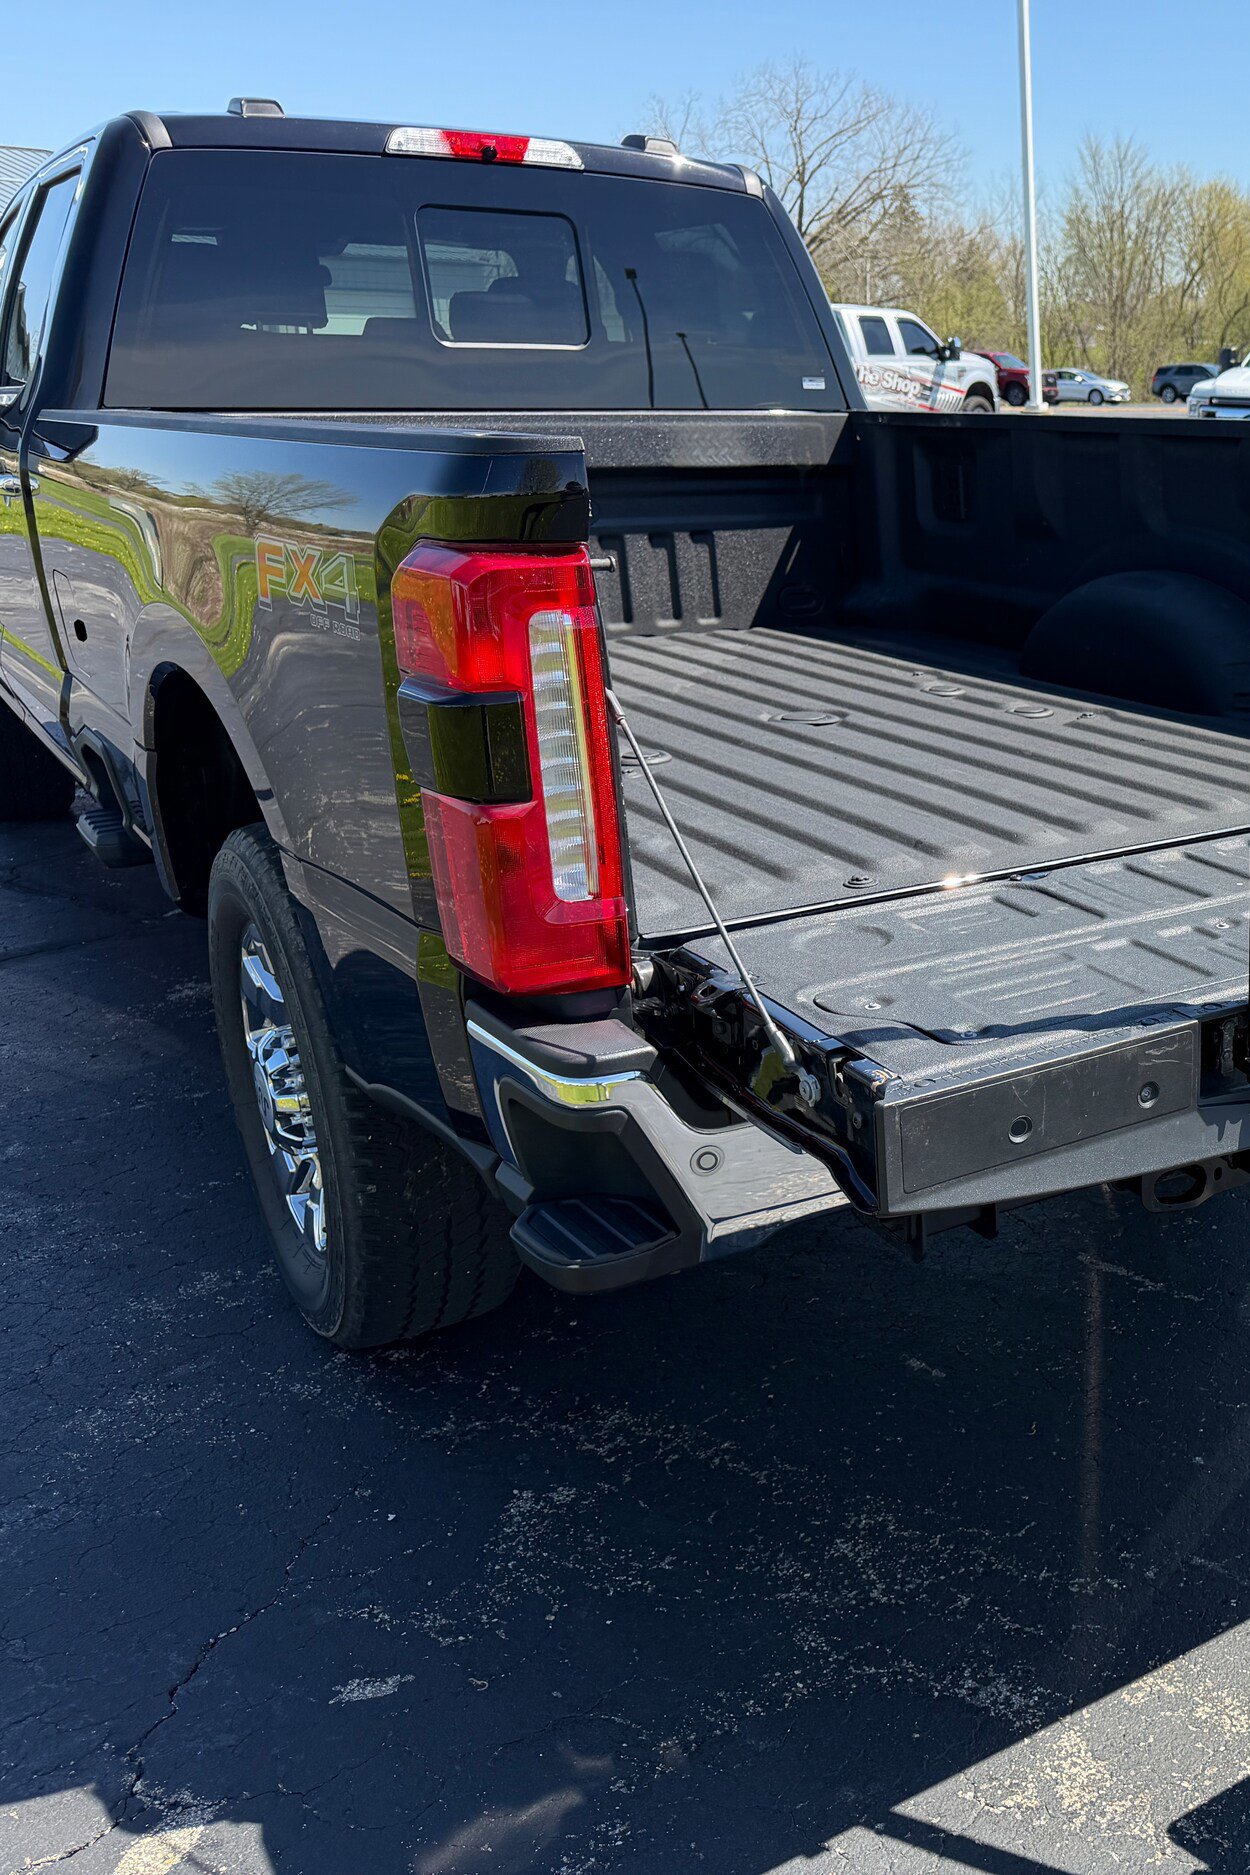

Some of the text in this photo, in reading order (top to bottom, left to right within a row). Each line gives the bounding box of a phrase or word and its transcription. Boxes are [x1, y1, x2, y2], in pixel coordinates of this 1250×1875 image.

[881, 369, 922, 402] Shop
[254, 532, 361, 625] FX4
[310, 613, 361, 642] OFF ROAD
